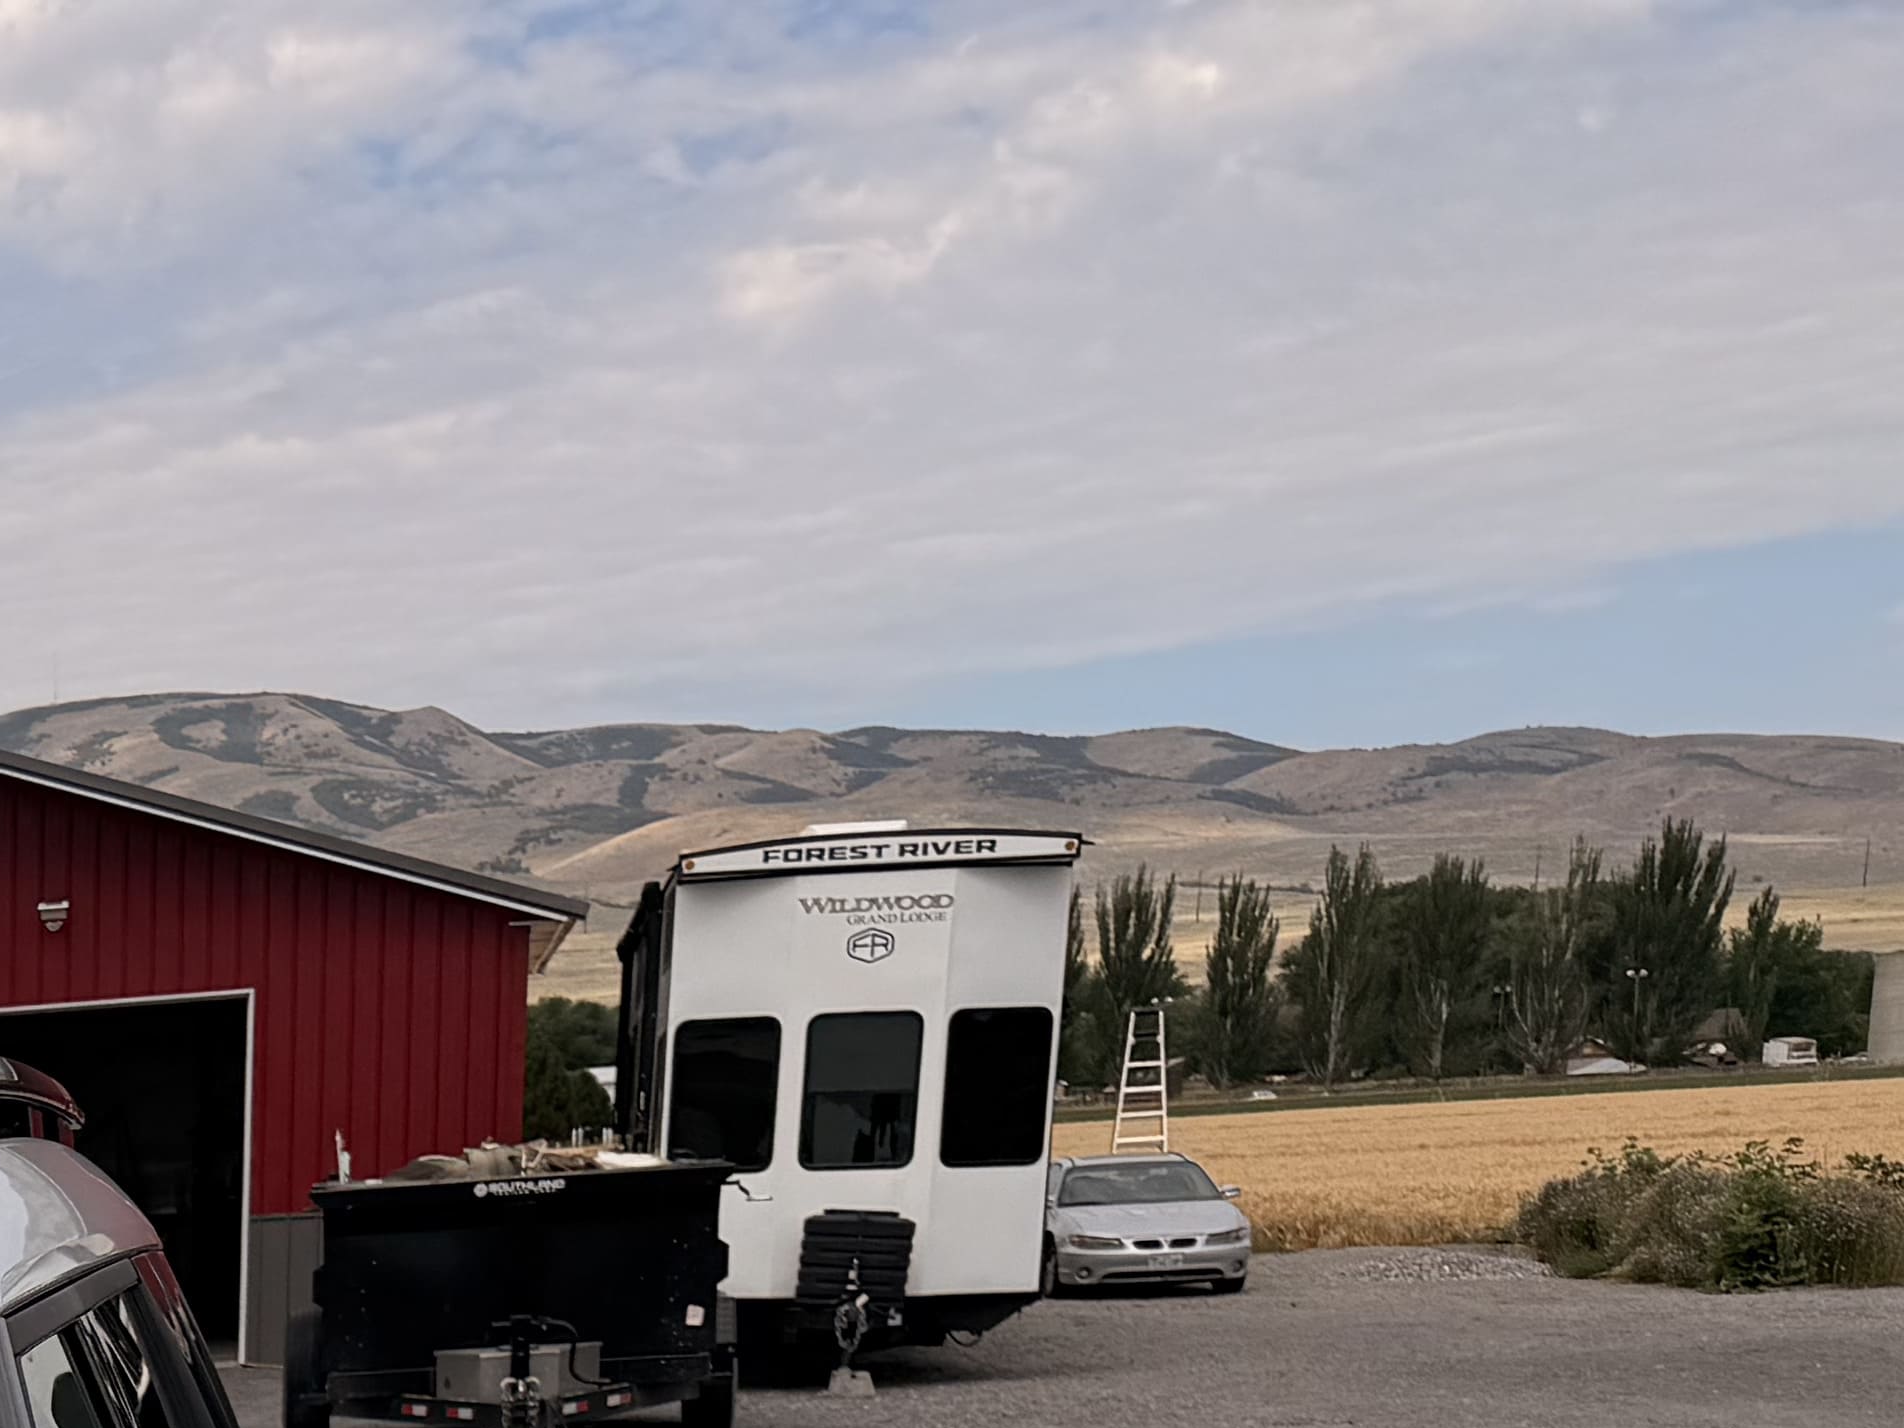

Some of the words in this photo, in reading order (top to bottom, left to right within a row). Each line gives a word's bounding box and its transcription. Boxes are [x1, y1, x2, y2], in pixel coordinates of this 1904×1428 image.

[762, 843, 890, 864] FOREST
[898, 838, 998, 857] RIVER
[798, 894, 954, 914] WILDWOOD
[846, 912, 897, 926] GRAND
[899, 910, 948, 924] LODGE
[488, 1179, 566, 1192] SOUTHLAND
